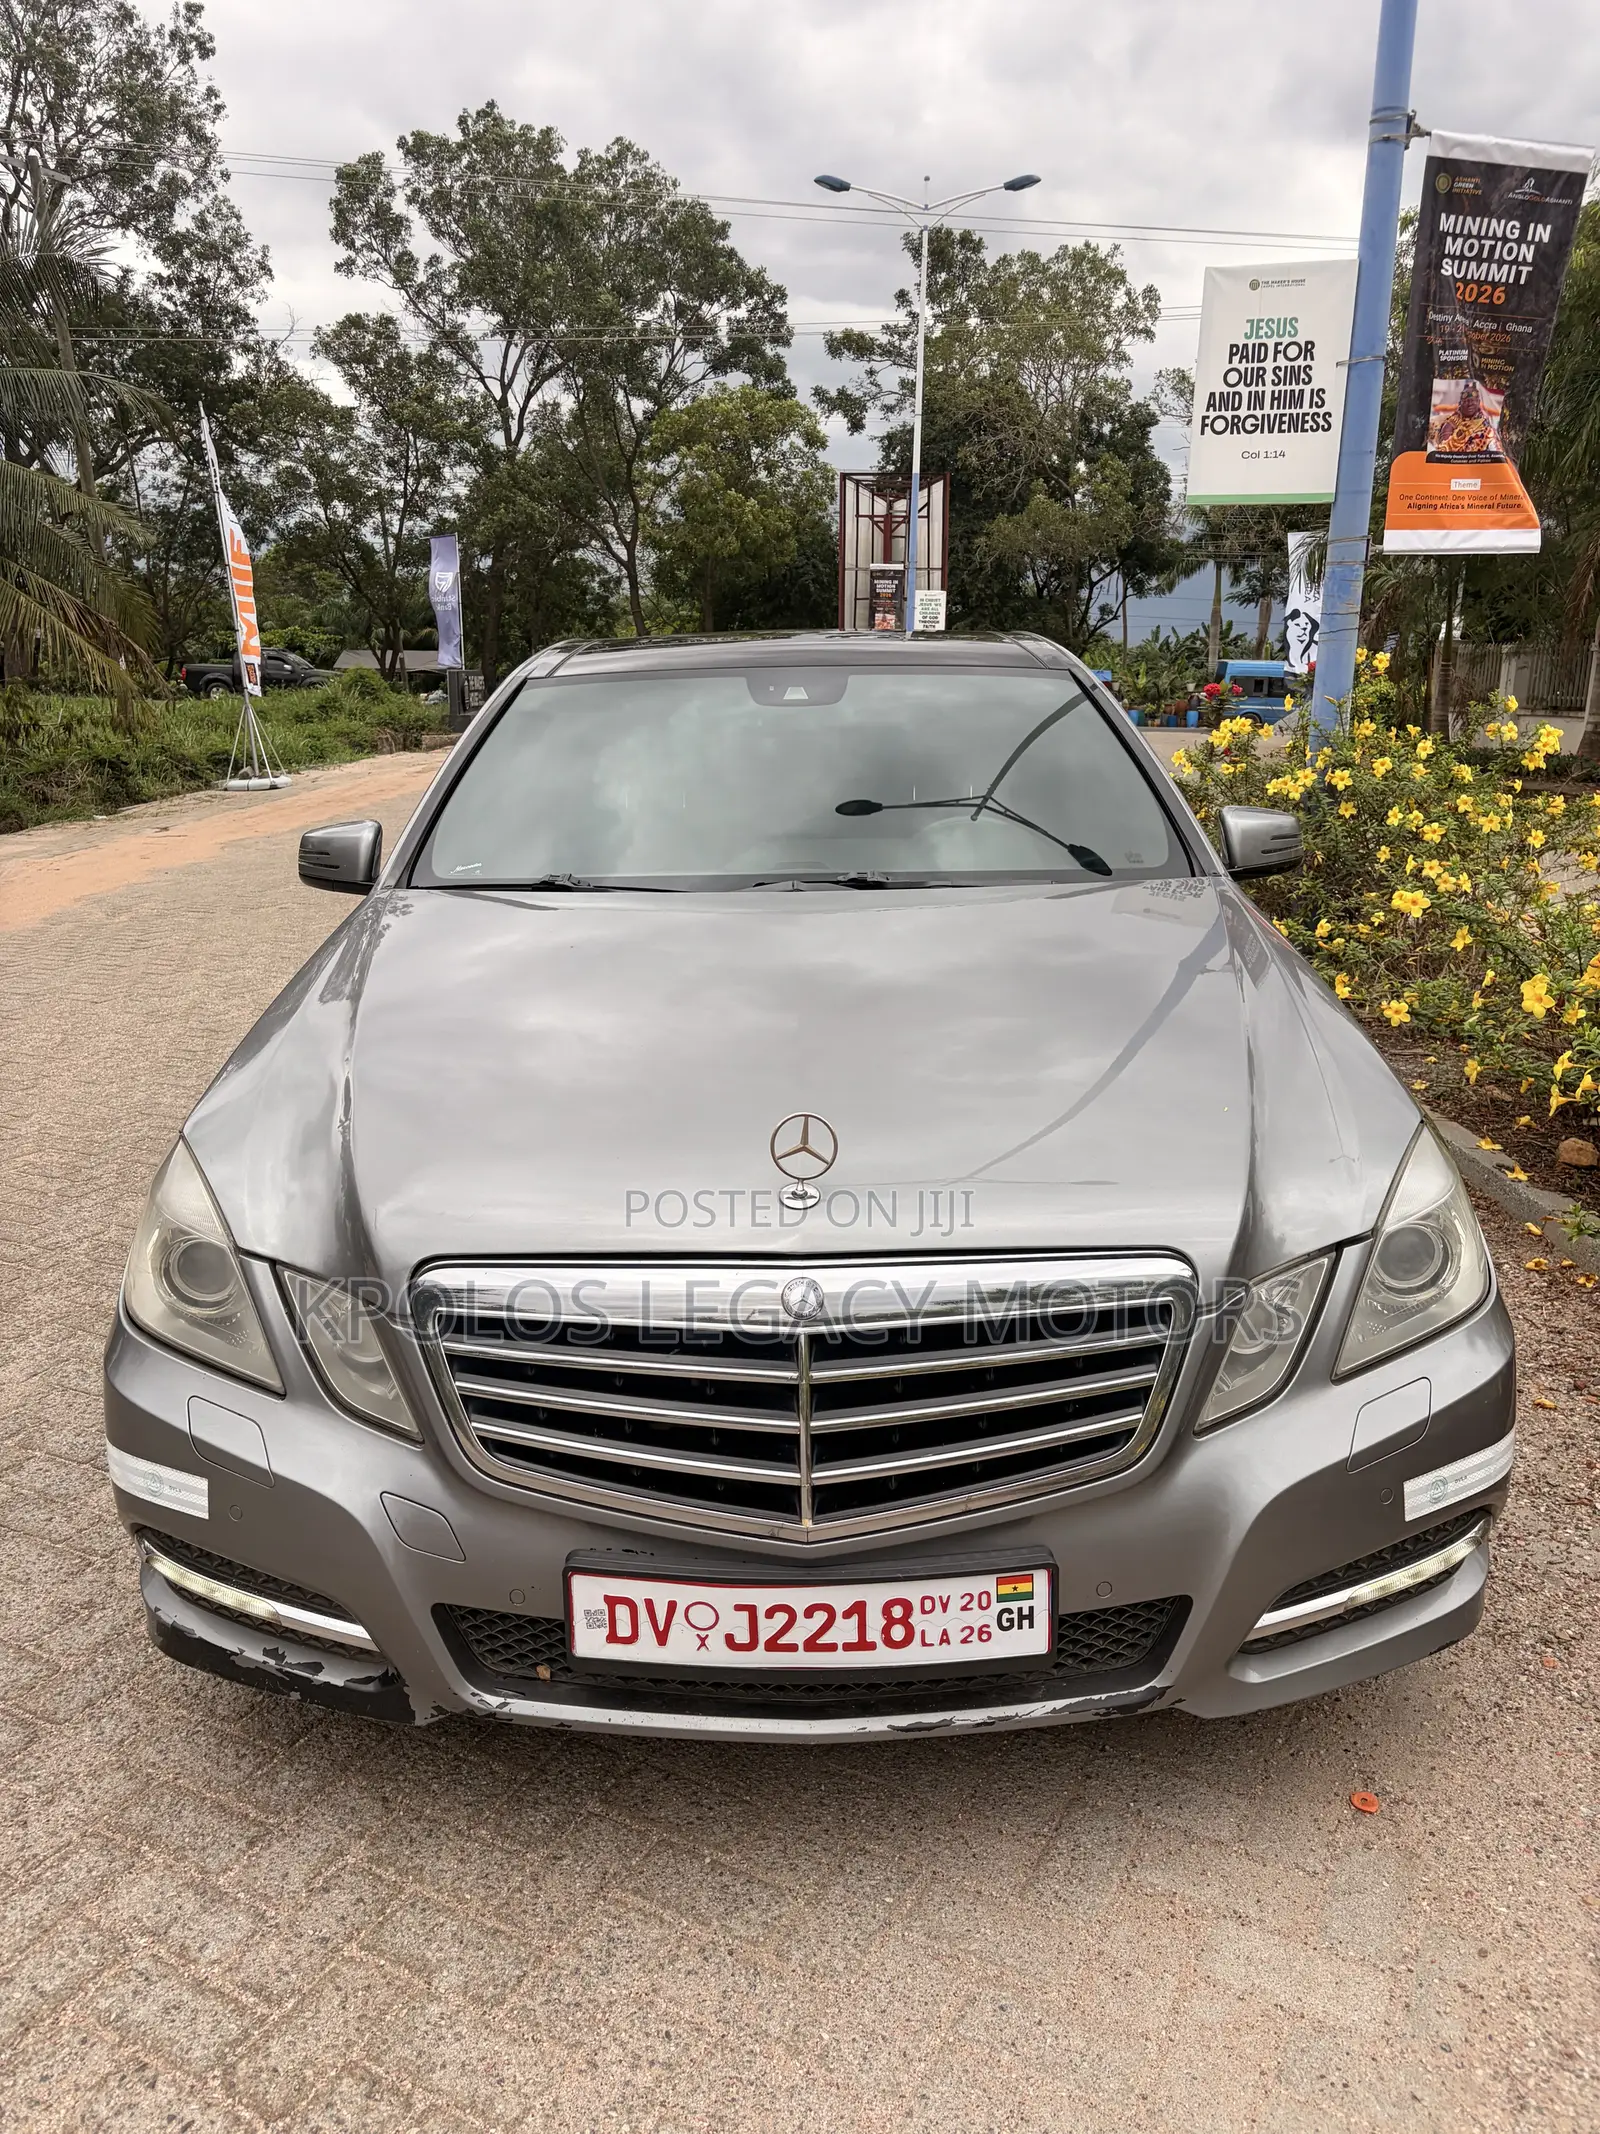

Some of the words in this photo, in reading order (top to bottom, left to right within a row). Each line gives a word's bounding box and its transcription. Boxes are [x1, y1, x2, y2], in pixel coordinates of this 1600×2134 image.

[1452, 188, 1483, 196] INITIATIVE
[1453, 176, 1481, 184] ASHANTI
[1439, 212, 1521, 239] MINING
[1527, 222, 1552, 244] IN
[1444, 236, 1535, 263] MOTION
[1440, 258, 1533, 285] SUMMIT
[1455, 281, 1506, 305] 2026
[1243, 317, 1299, 340] JESUS
[1428, 311, 1453, 324] Destiny
[1473, 320, 1498, 330] Accra
[1505, 322, 1533, 333] Ghana
[1490, 333, 1512, 343] 2026
[1228, 342, 1268, 364] PAID
[1272, 340, 1316, 363] FOR
[1480, 358, 1506, 366] MINING
[1223, 367, 1266, 388] OUR
[1271, 364, 1313, 387] SINS
[1487, 364, 1515, 373] MOTION
[1205, 390, 1243, 413] AND
[1247, 390, 1265, 411] IN
[1269, 389, 1304, 411] HIM
[1309, 388, 1326, 409] IS
[1200, 412, 1332, 436] FORGIVENESS
[1241, 450, 1260, 460] Col
[1263, 450, 1286, 459] 1:14
[1399, 493, 1413, 501] One
[1407, 503, 1438, 511] Aligning
[920, 1595, 951, 1616] DV
[960, 1590, 992, 1612] 20
[603, 1594, 678, 1647] DV
[724, 1598, 914, 1653] J2218
[996, 1606, 1035, 1631] GH
[920, 1628, 951, 1648] LA
[960, 1624, 992, 1645] 26
